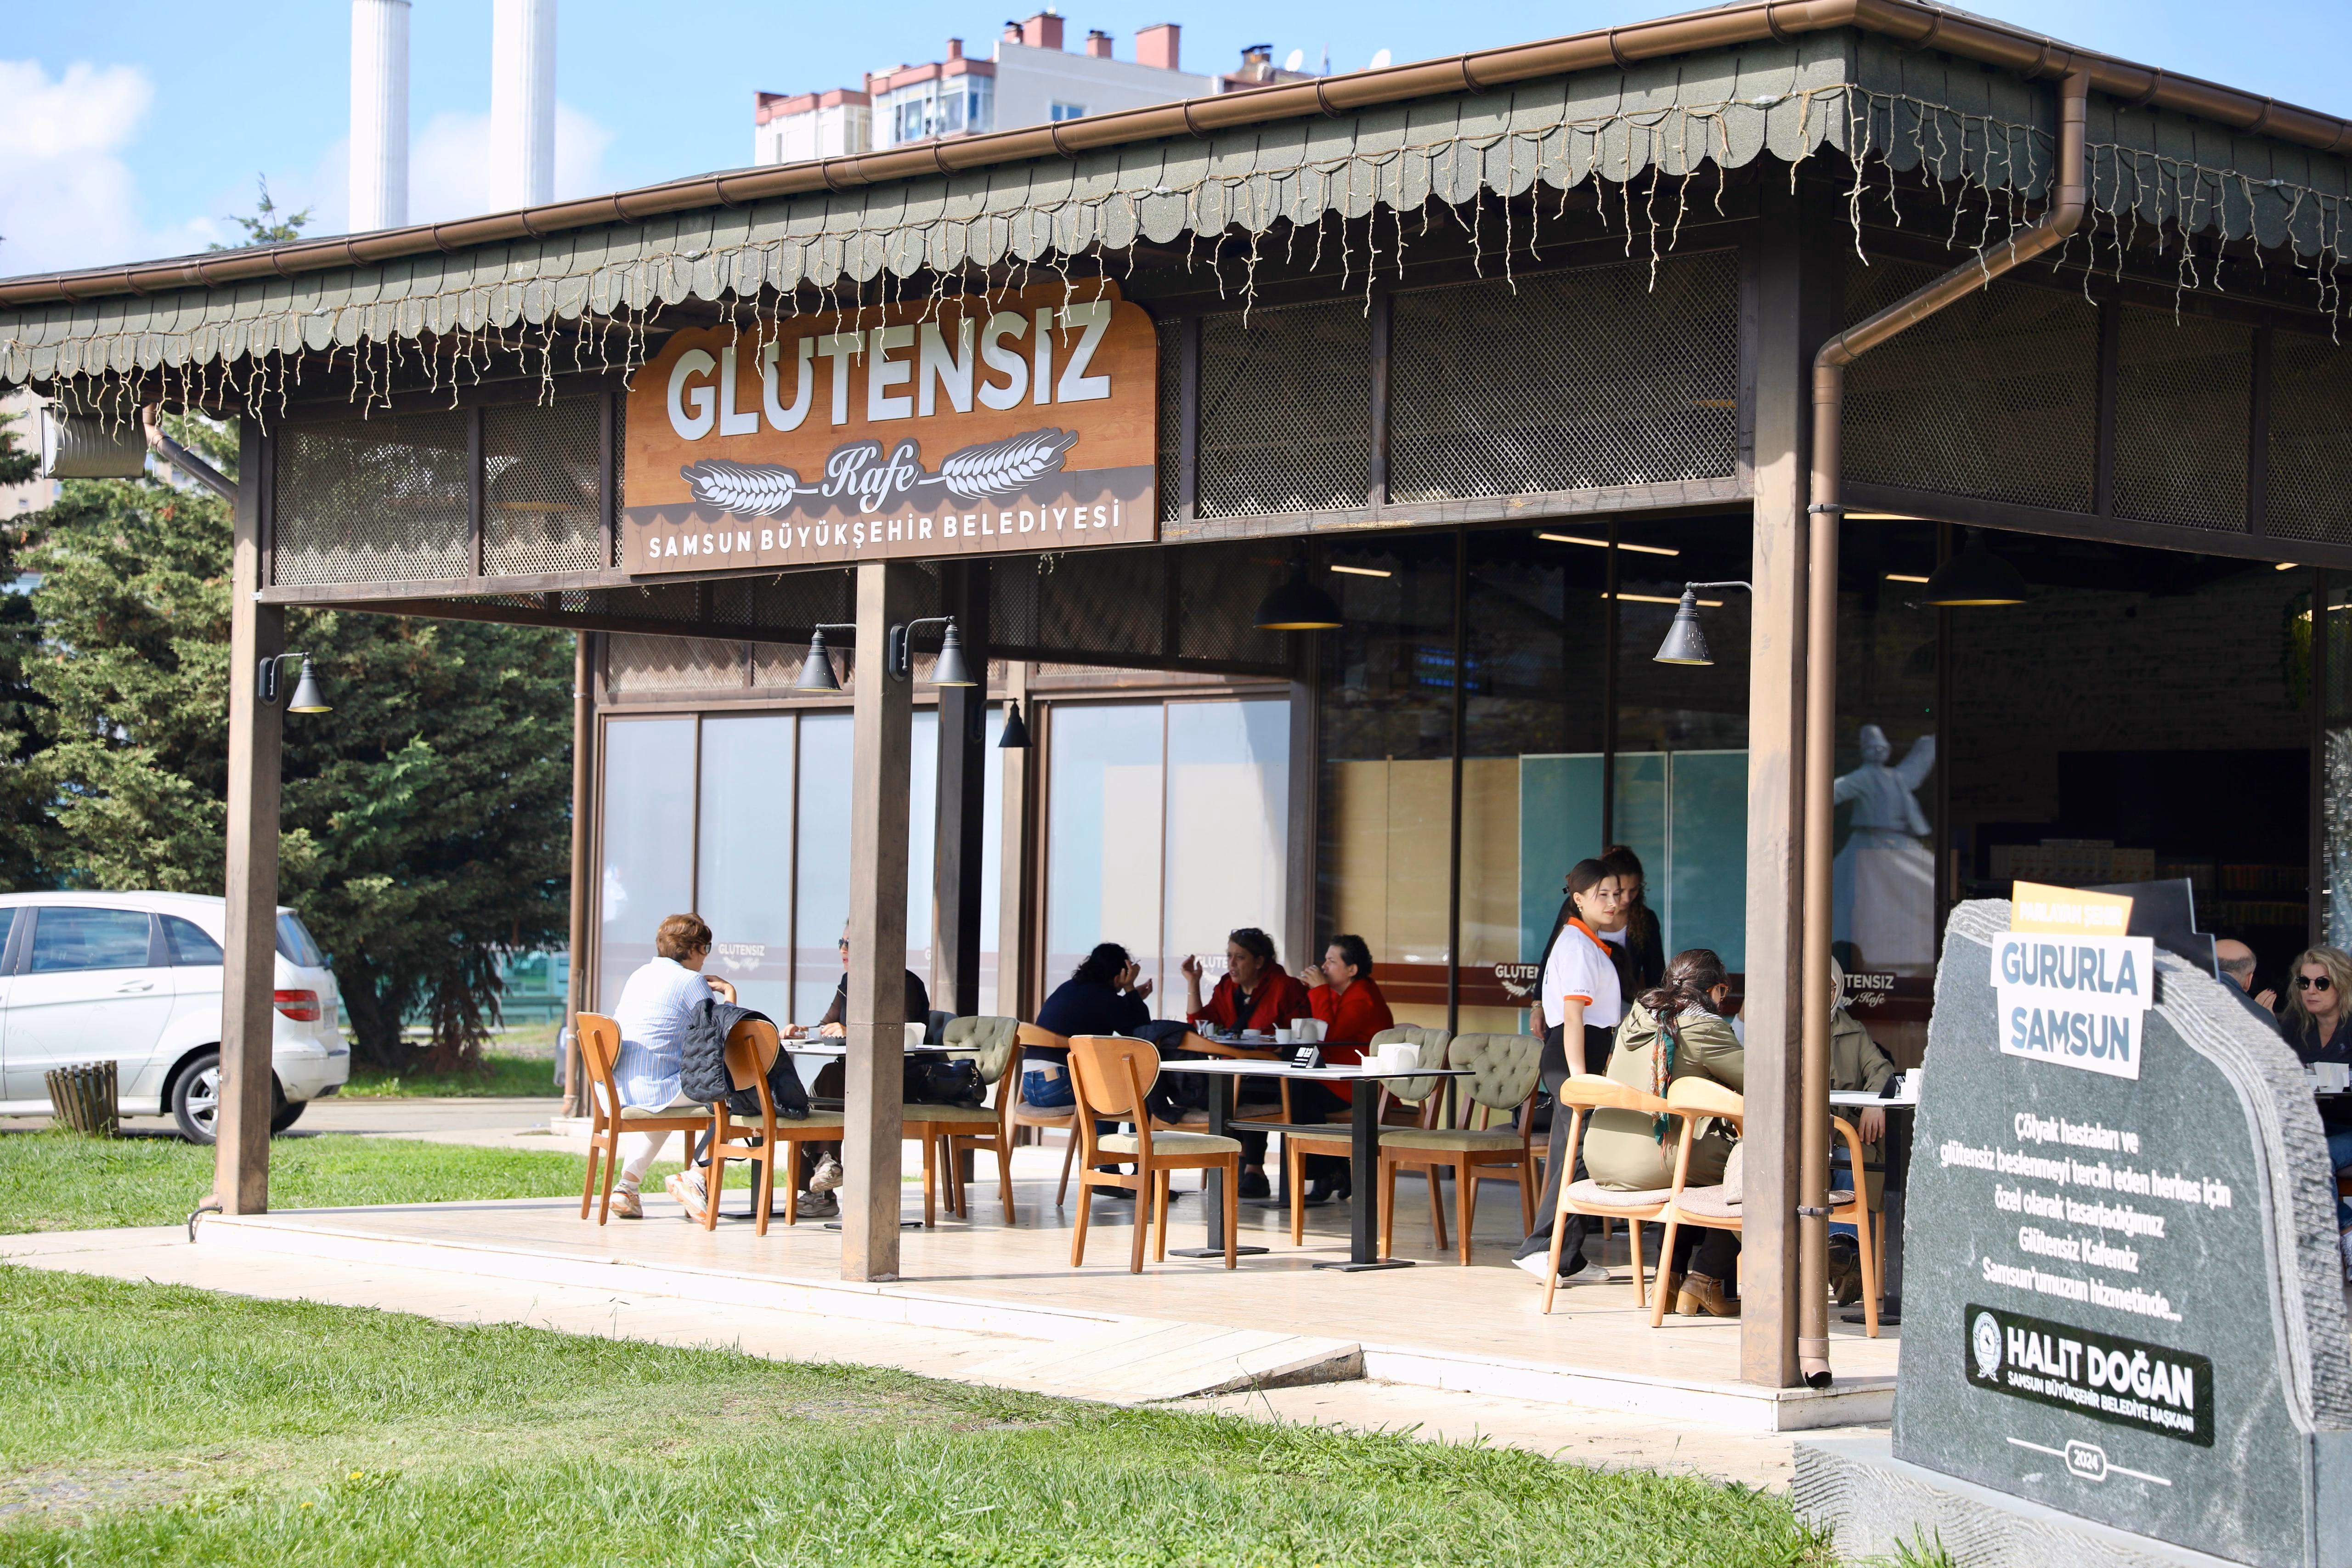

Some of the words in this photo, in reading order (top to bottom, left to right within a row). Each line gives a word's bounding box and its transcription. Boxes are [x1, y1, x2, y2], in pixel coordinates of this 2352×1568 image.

[822, 445, 919, 514] Kafe
[650, 531, 750, 558] SAMSUN
[761, 513, 932, 550] BÜYÜKŞEHİR
[944, 498, 1119, 538] BELEDİYESİ
[1845, 974, 1894, 989] TENSIZ
[2001, 942, 2138, 996] GURURLA
[2011, 1007, 2129, 1062] SAMSUN
[2014, 1112, 2059, 1144] Çölyak
[2061, 1117, 2119, 1151] hastaları
[2121, 1132, 2138, 1154] ve
[1940, 1140, 1995, 1171] glütensiz
[1996, 1146, 2070, 1186] beslenmeyi
[2072, 1159, 2112, 1190] tercih
[2113, 1166, 2149, 1195] eden
[2151, 1169, 2201, 1204] herkes
[2203, 1177, 2231, 1211] için
[1995, 1184, 2021, 1212] özel
[2023, 1189, 2064, 1220] olarak
[2066, 1197, 2165, 1238] tasarladığımız
[2018, 1226, 2080, 1262] Glütensiz
[2081, 1238, 2138, 1274] Kafemiz
[2090, 1278, 2182, 1322] hizmetinde...
[2008, 1371, 2044, 1393] SAMSUN
[2045, 1379, 2100, 1409] BÜYÜKŞEHİR
[2101, 1395, 2149, 1421] BELEDİYE
[2150, 1406, 2194, 1432] BAŞKANI
[2087, 1349, 2194, 1410] DOĞAN
[2074, 1449, 2099, 1470] 2024
